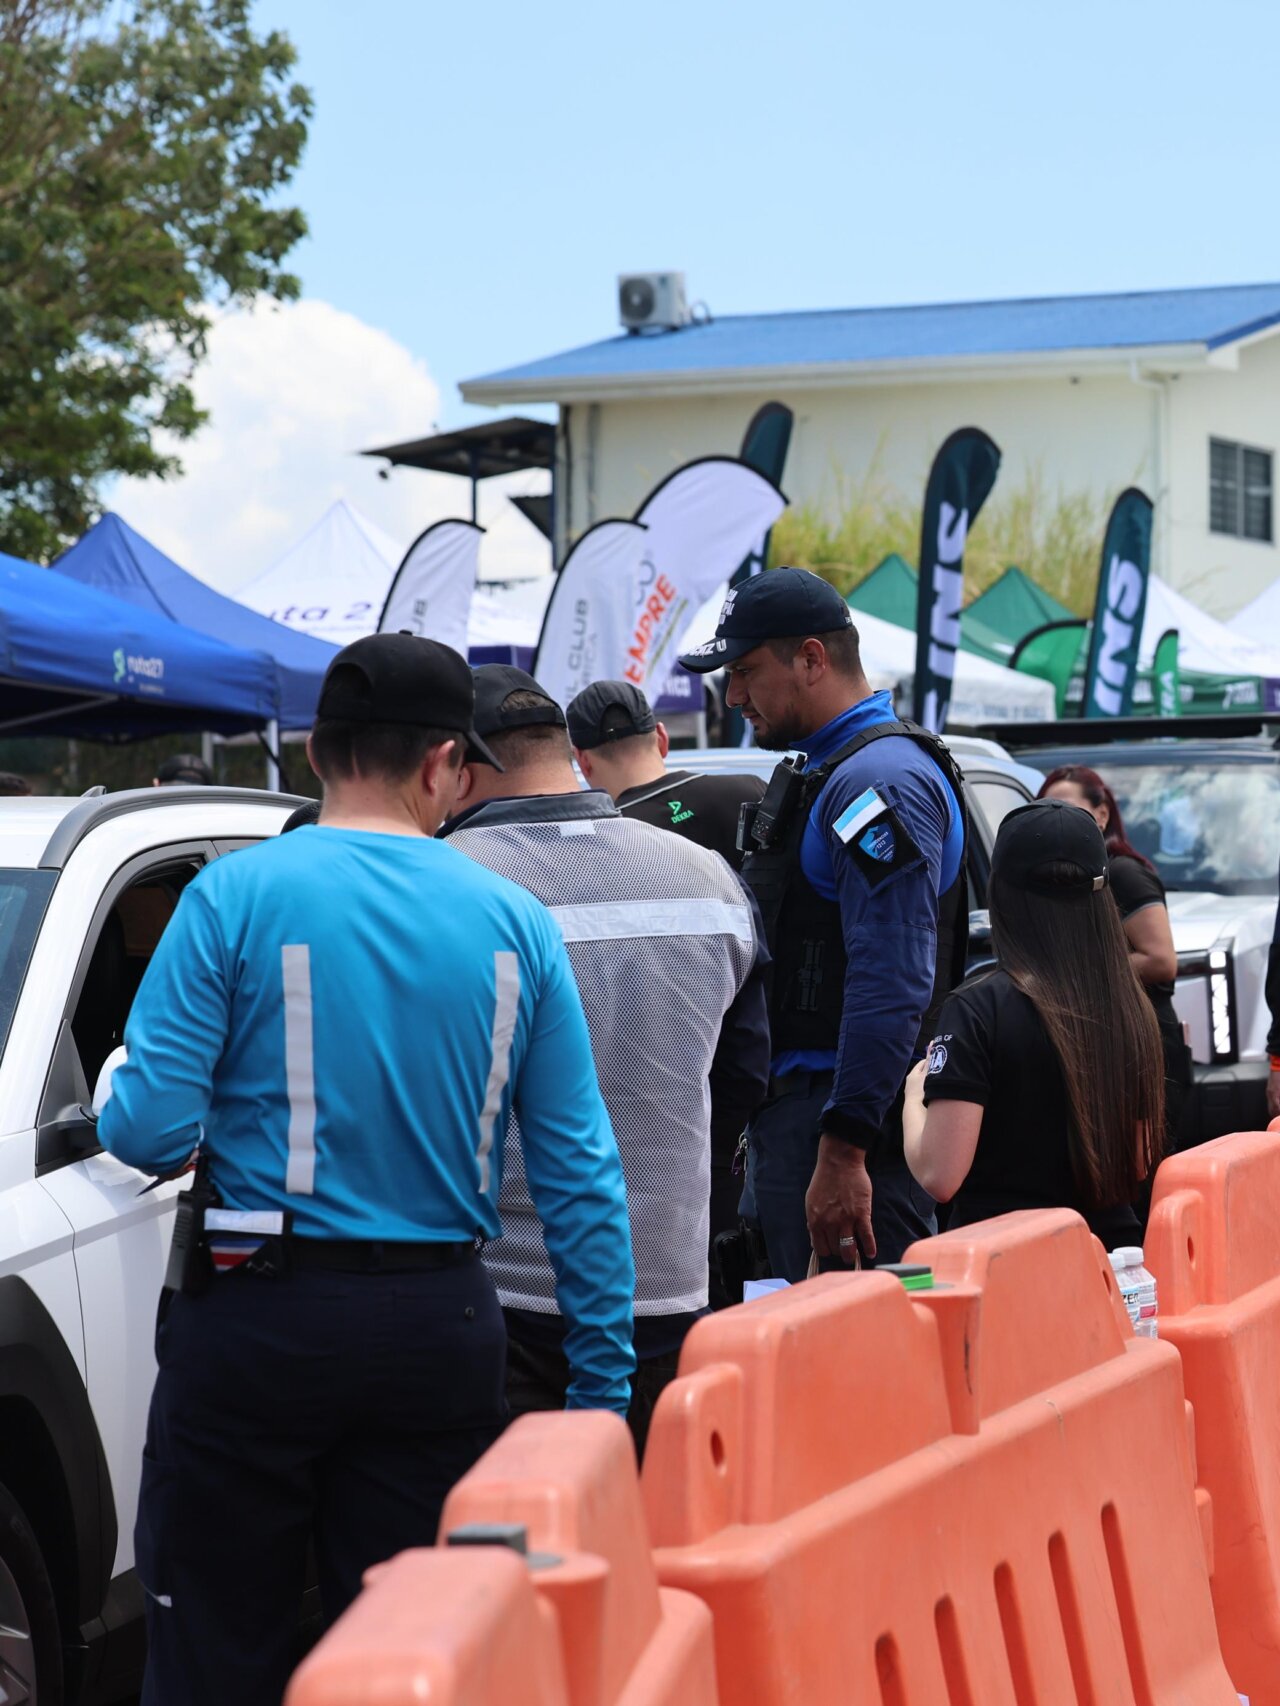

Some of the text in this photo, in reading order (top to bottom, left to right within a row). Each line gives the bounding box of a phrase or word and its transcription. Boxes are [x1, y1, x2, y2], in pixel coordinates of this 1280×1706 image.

[623, 574, 678, 686] EMPRE
[927, 501, 969, 680] INS
[1093, 552, 1143, 716] INS
